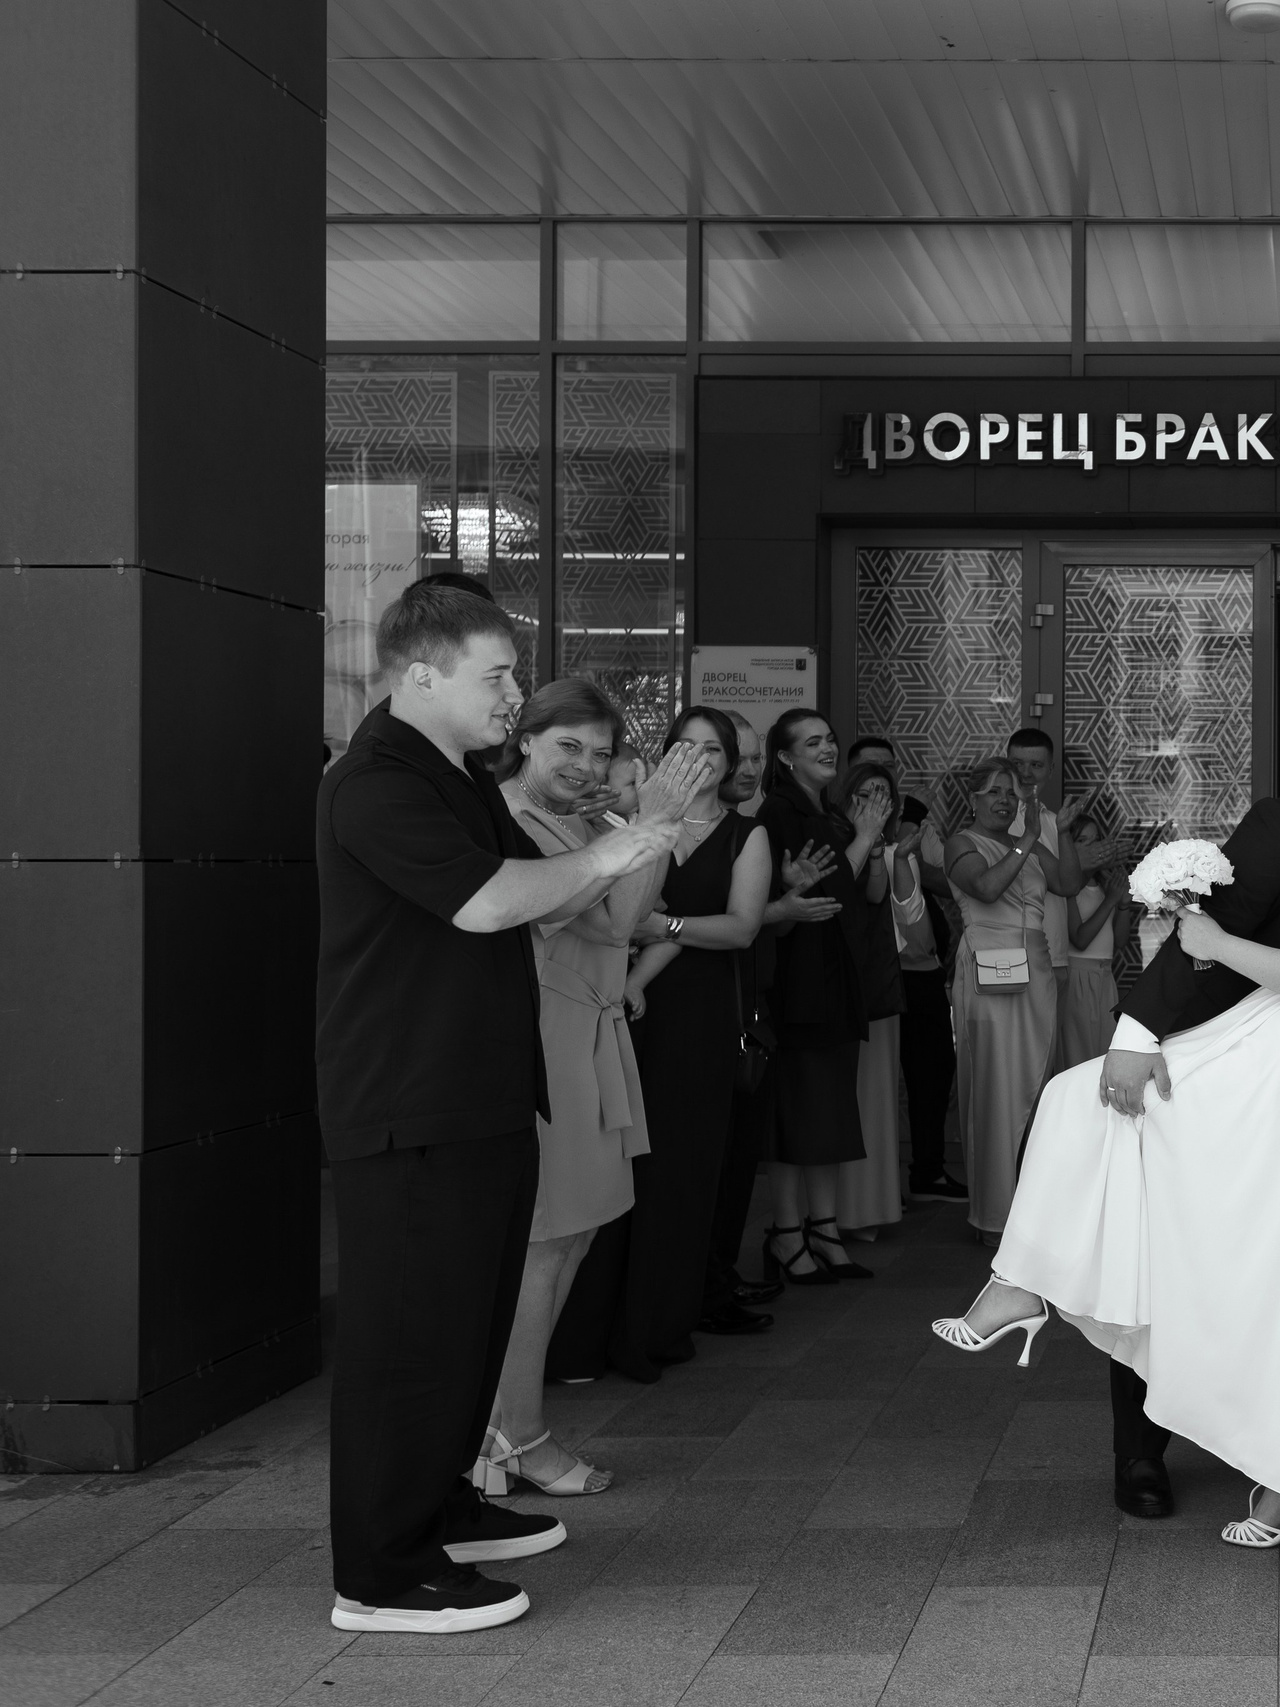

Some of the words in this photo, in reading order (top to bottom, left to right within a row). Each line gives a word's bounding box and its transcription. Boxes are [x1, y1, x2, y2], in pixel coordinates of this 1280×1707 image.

[834, 412, 1093, 470] ДВОРЕЦ
[325, 533, 370, 548] торая
[702, 672, 746, 683] ДВОРЕЦ
[702, 687, 803, 696] БРАКОСОЧЕТАНИЯ
